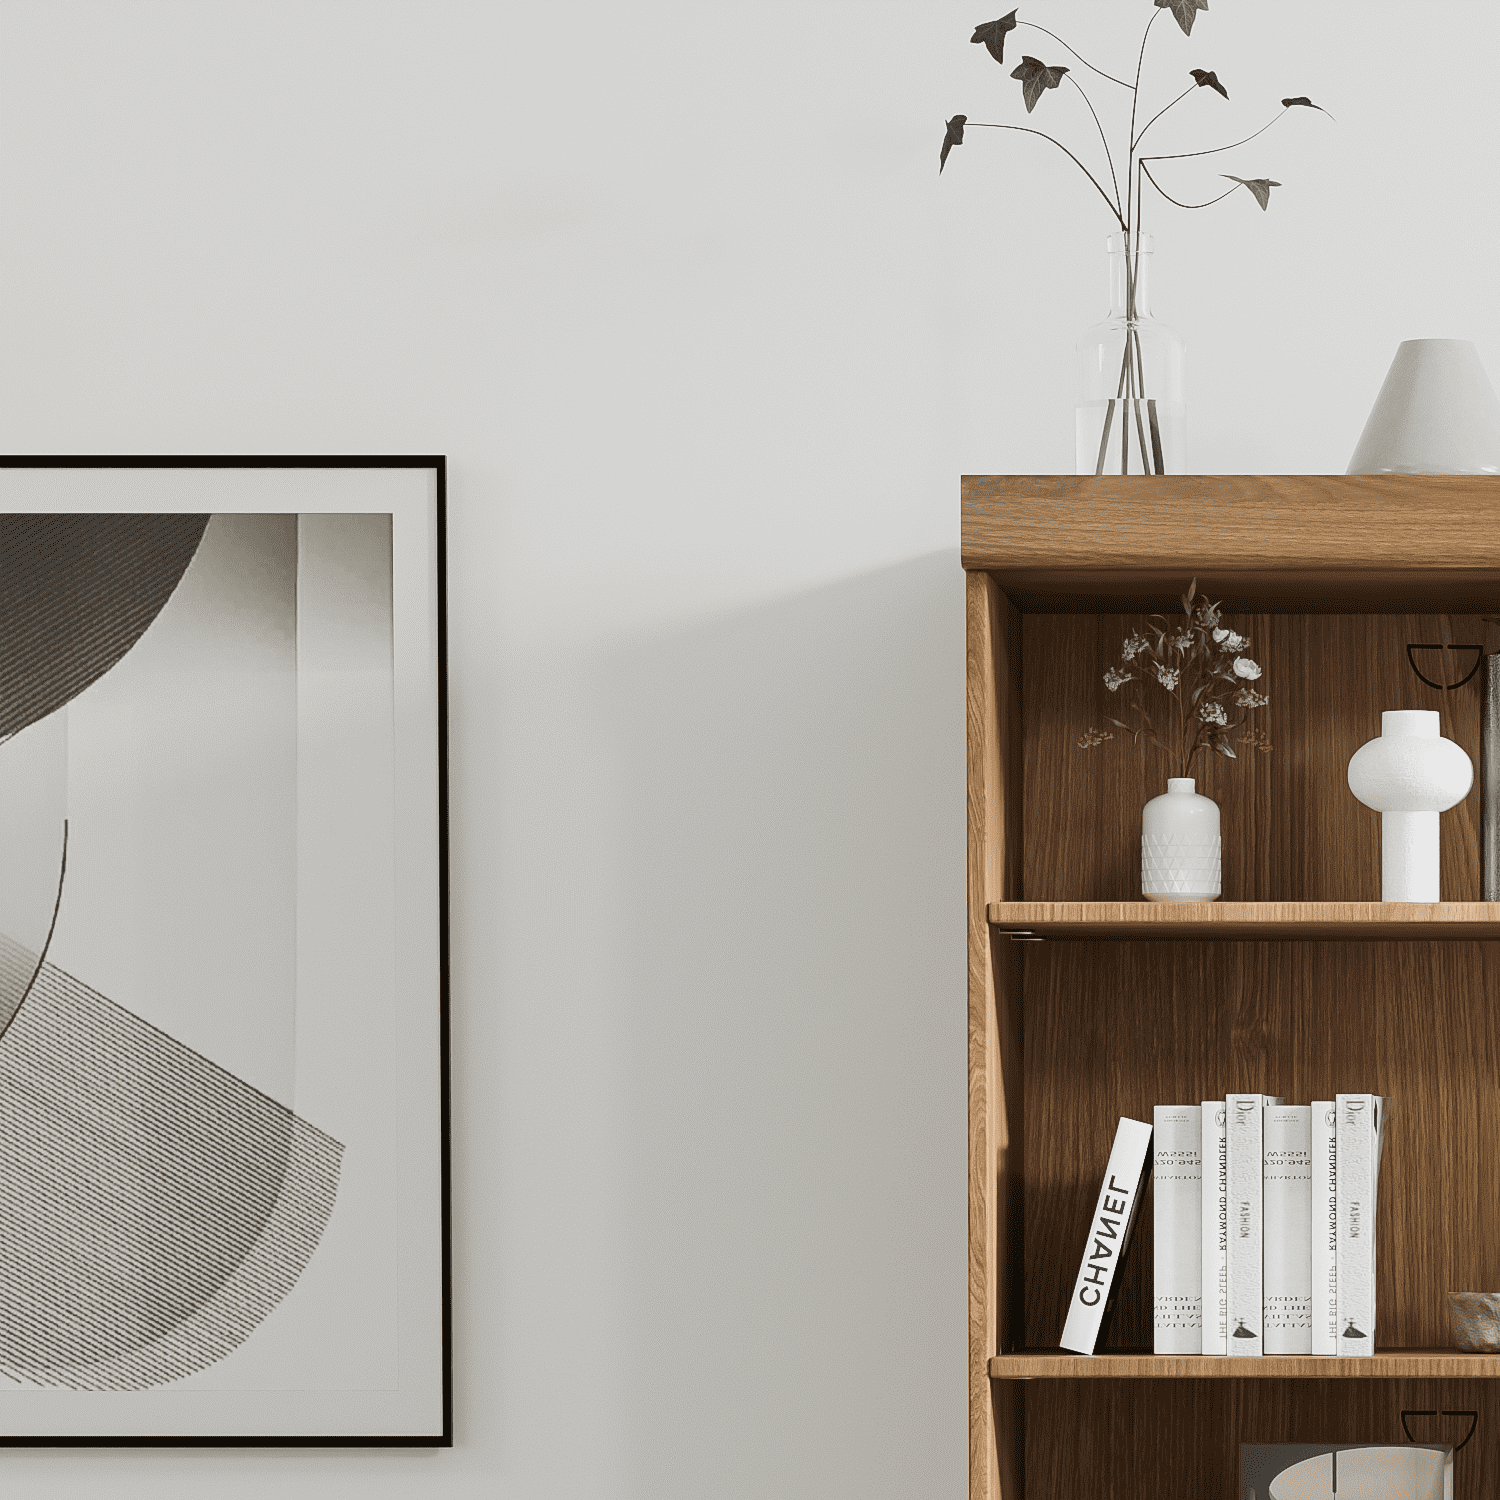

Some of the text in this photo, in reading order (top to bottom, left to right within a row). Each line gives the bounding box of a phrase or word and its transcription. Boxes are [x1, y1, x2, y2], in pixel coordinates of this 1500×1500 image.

[1235, 1100, 1255, 1127] Dior
[1345, 1100, 1365, 1127] Dior
[1239, 1201, 1250, 1239] FASHION
[1349, 1201, 1360, 1239] FASHION
